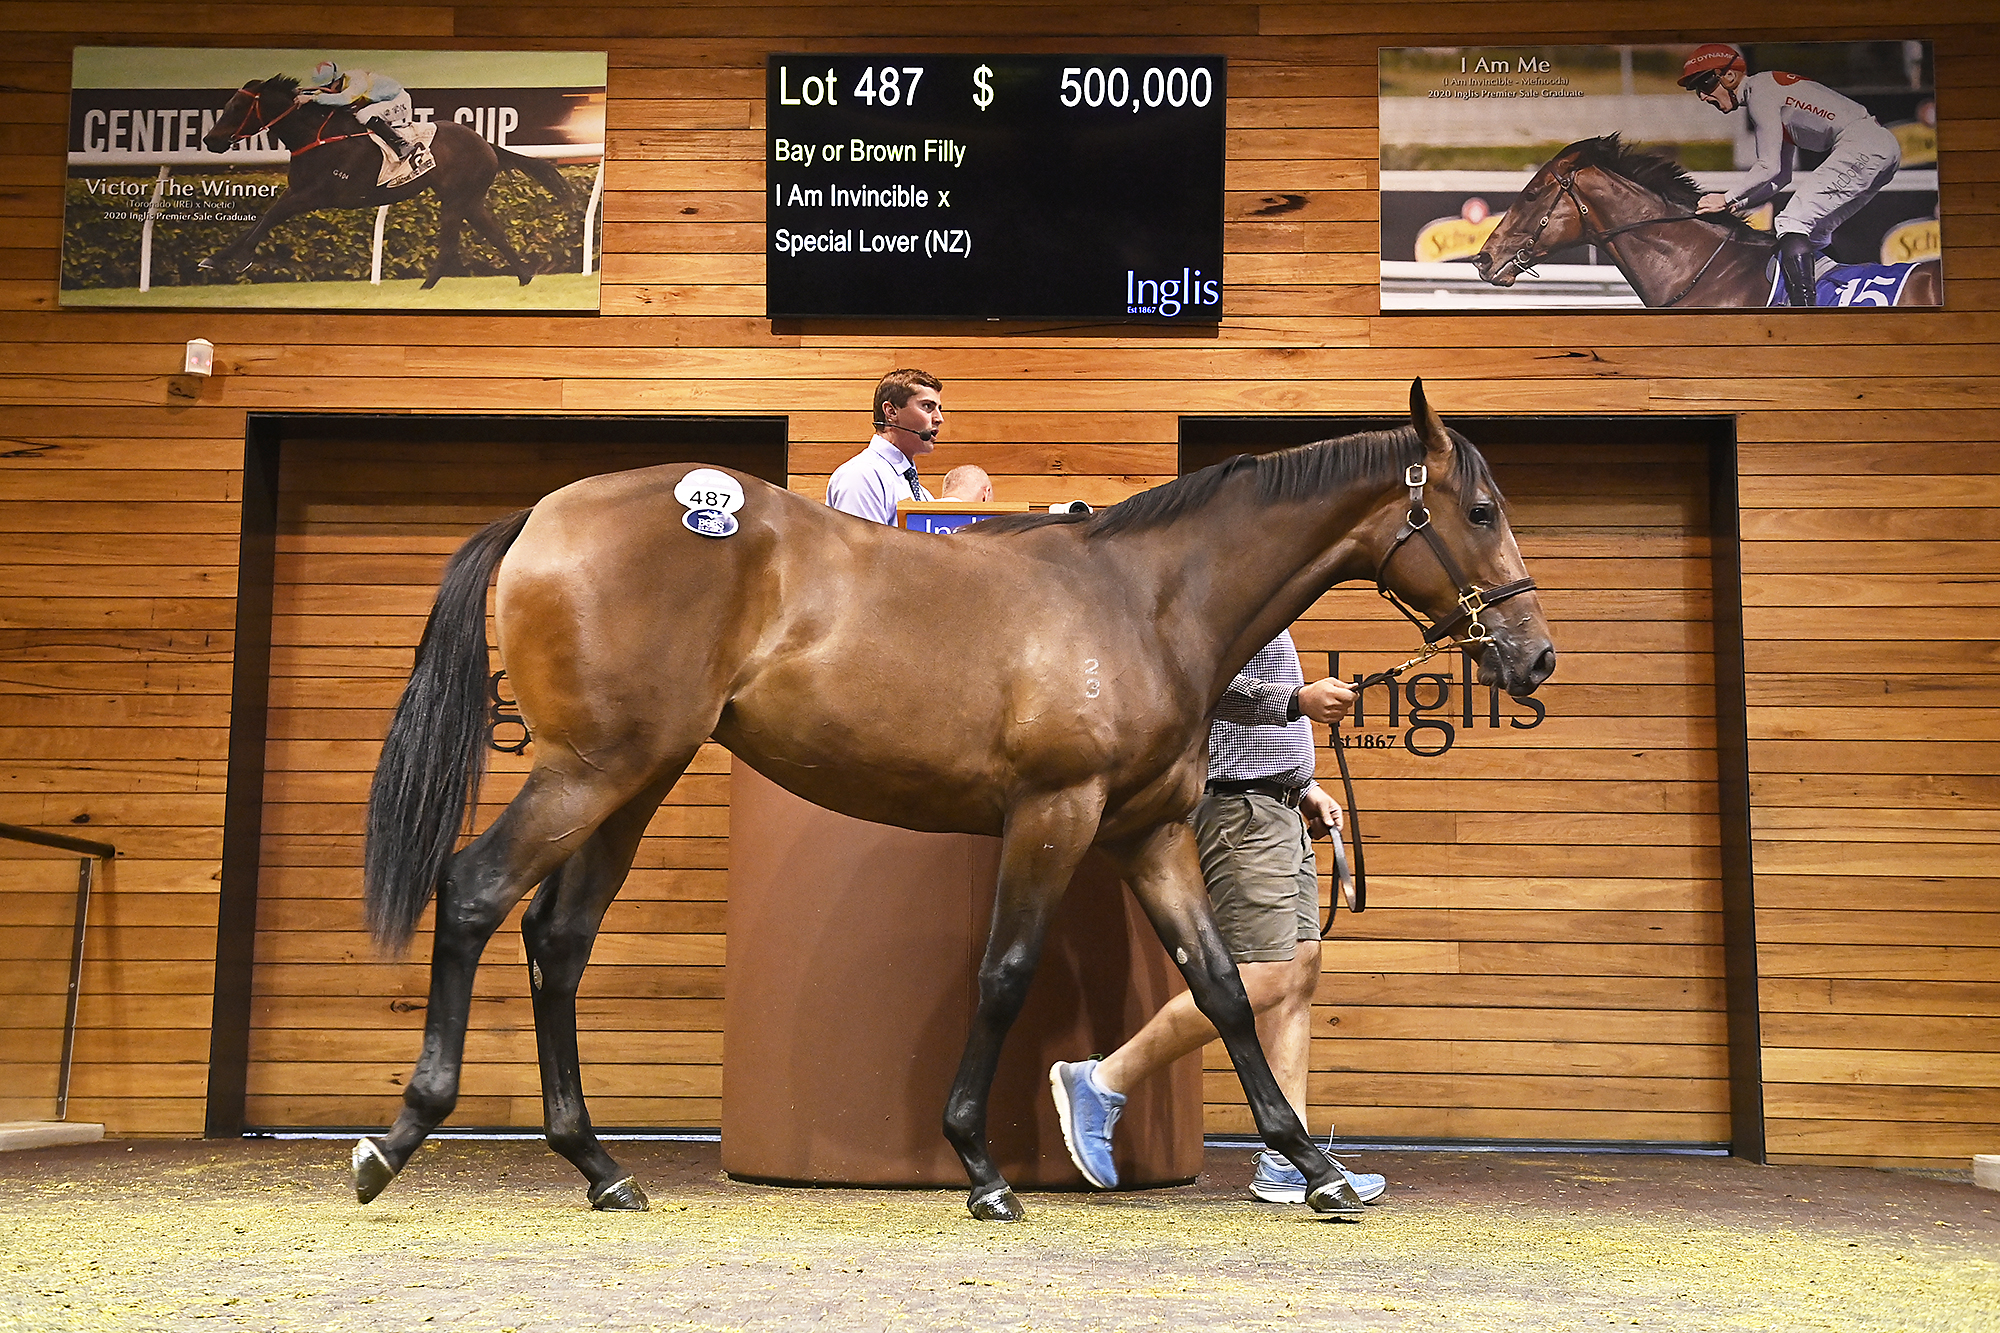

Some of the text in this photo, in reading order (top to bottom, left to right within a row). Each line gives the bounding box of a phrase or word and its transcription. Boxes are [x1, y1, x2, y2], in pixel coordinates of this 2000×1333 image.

[1461, 56, 1551, 73] I Am Me
[781, 64, 1212, 113] Lot 487 $ 500,000
[1451, 77, 1467, 86] Am
[1468, 77, 1513, 86] Invincible
[1428, 90, 1584, 100] 2020 Inglis Premier Sale Graduate
[776, 139, 967, 168] Bay or Brown Filly
[85, 179, 278, 198] Victor The Winner
[776, 184, 951, 208] I Am Invincible x
[173, 200, 193, 210] (IRE)
[104, 212, 257, 222] 2020 Inglis Premier Sale Graduate
[775, 229, 972, 258] Special Lover (NZ)
[1127, 267, 1219, 317] Inglis
[1835, 275, 1896, 306] 15
[1127, 306, 1157, 314] Est 1867
[689, 490, 731, 508] 487
[1355, 734, 1397, 749] 1867
